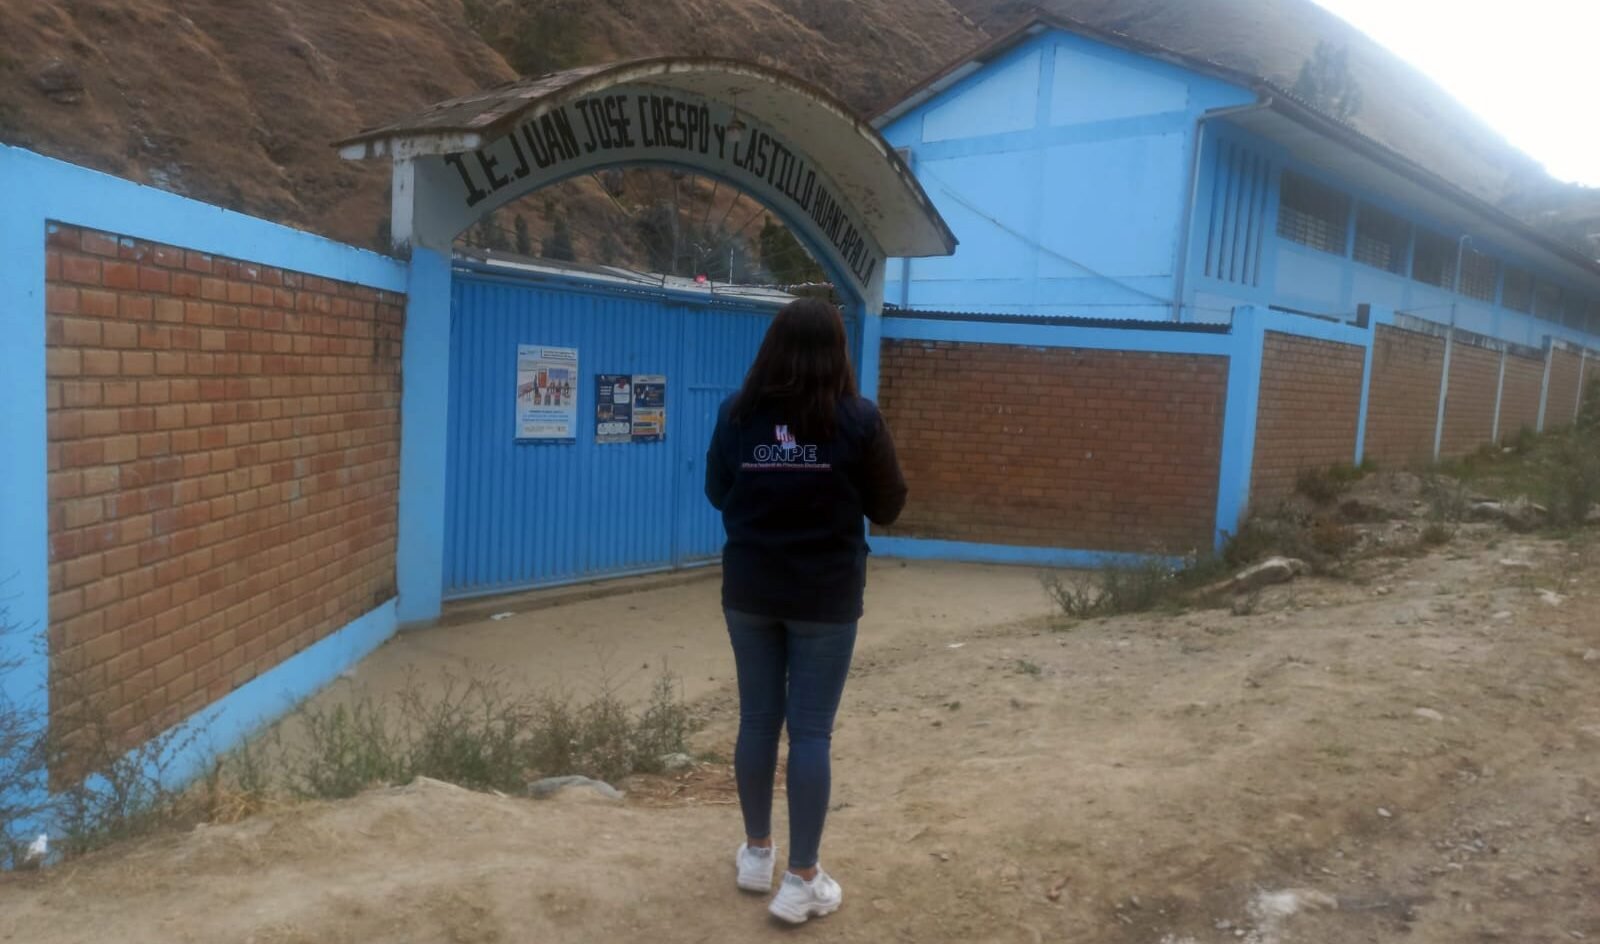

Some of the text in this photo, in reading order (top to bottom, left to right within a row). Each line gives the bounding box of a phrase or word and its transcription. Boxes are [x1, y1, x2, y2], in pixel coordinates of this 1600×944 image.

[509, 105, 580, 176] JUAN
[575, 96, 634, 153] JOSE
[638, 95, 710, 154] CRESPO
[714, 123, 726, 159] Y
[753, 444, 818, 462] ONPE
